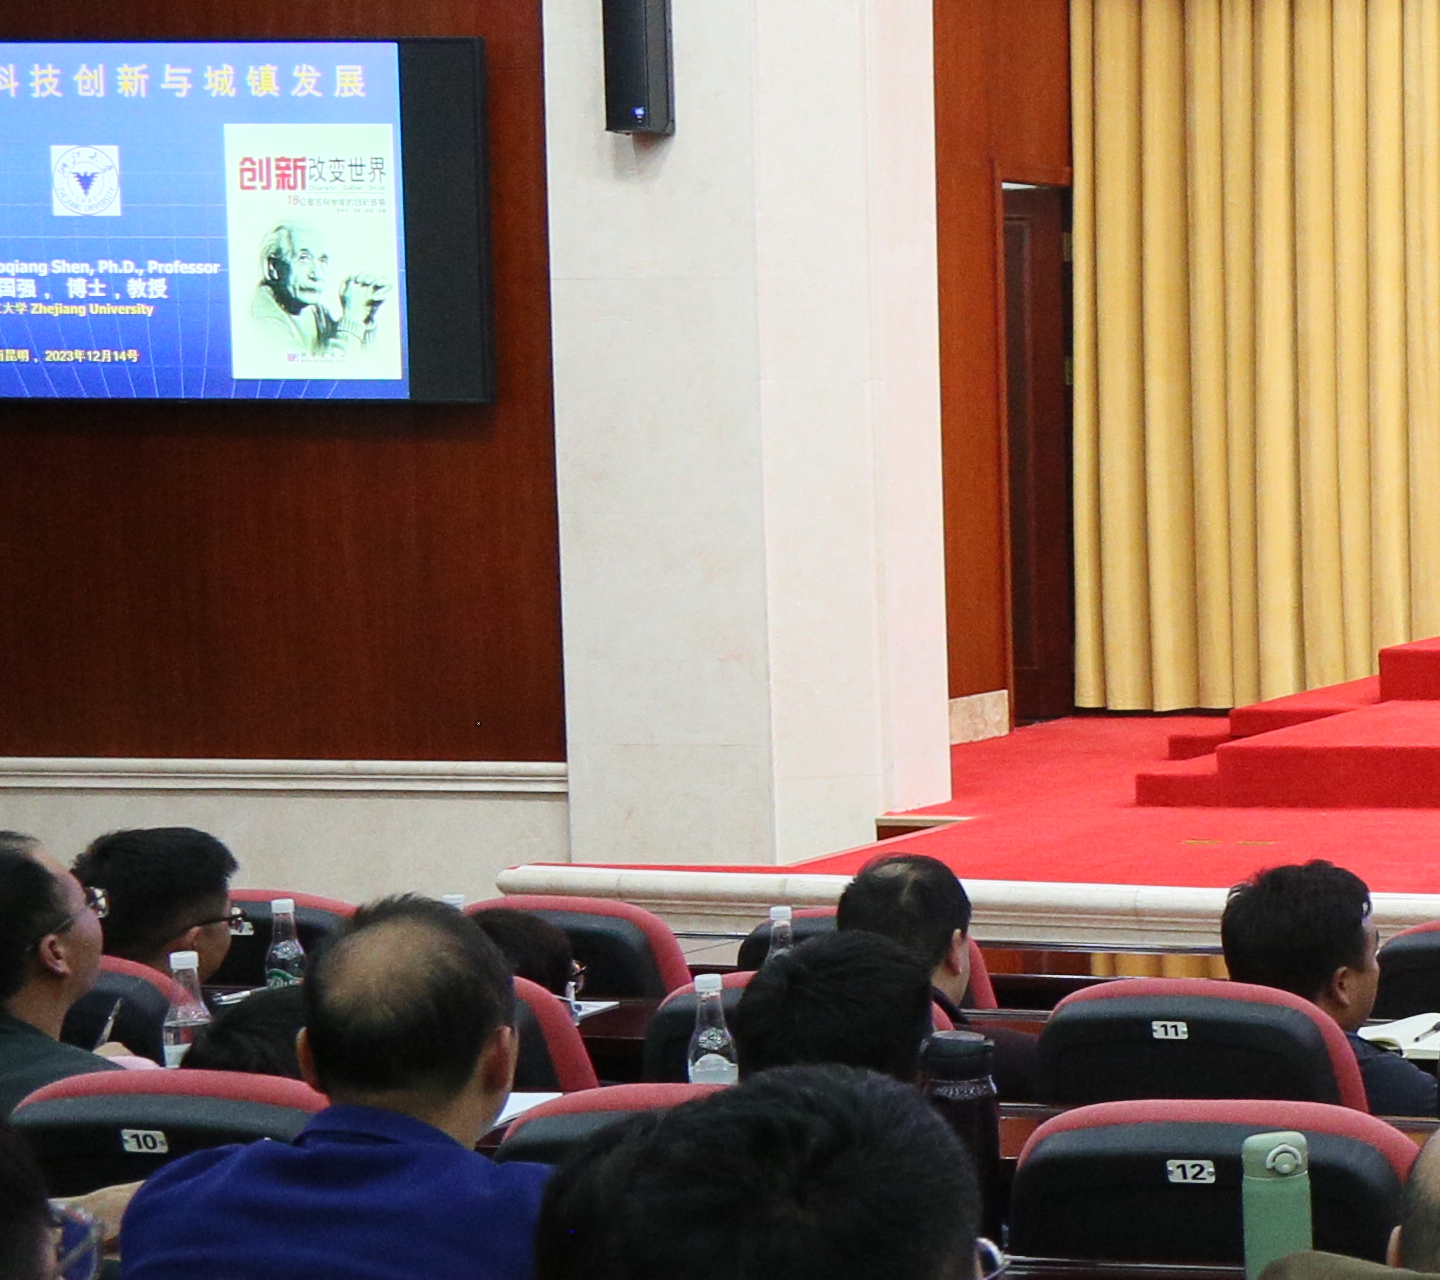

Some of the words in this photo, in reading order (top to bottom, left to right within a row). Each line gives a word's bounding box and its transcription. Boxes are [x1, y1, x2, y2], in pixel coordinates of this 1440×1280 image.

[51, 261, 94, 276] Shen,
[99, 261, 144, 276] Ph.D.,
[148, 261, 221, 275] Professor
[30, 304, 86, 317] Zhejiang
[89, 304, 154, 317] University
[1161, 1024, 1178, 1036] 11
[131, 1131, 158, 1150] 10
[1176, 1163, 1206, 1180] 12
